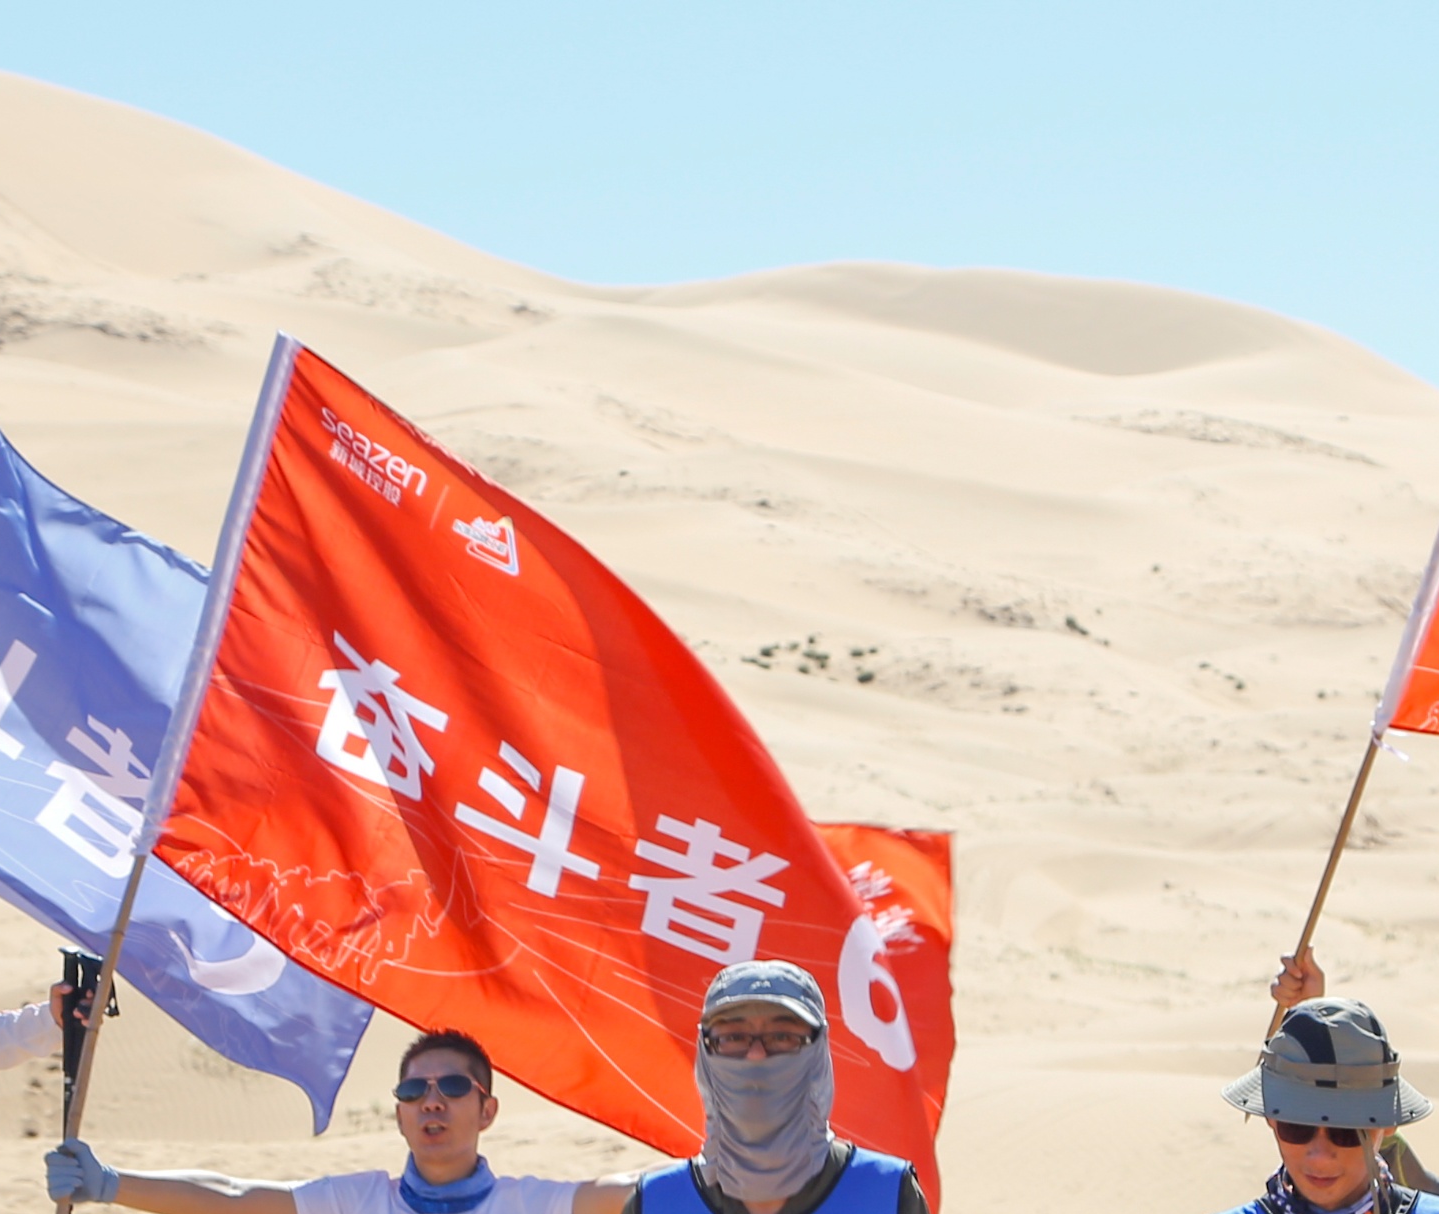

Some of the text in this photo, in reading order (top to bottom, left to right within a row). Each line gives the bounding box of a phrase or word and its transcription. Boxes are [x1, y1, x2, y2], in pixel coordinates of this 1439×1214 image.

[321, 407, 428, 496] seazen
[316, 630, 790, 965] 奋斗者
